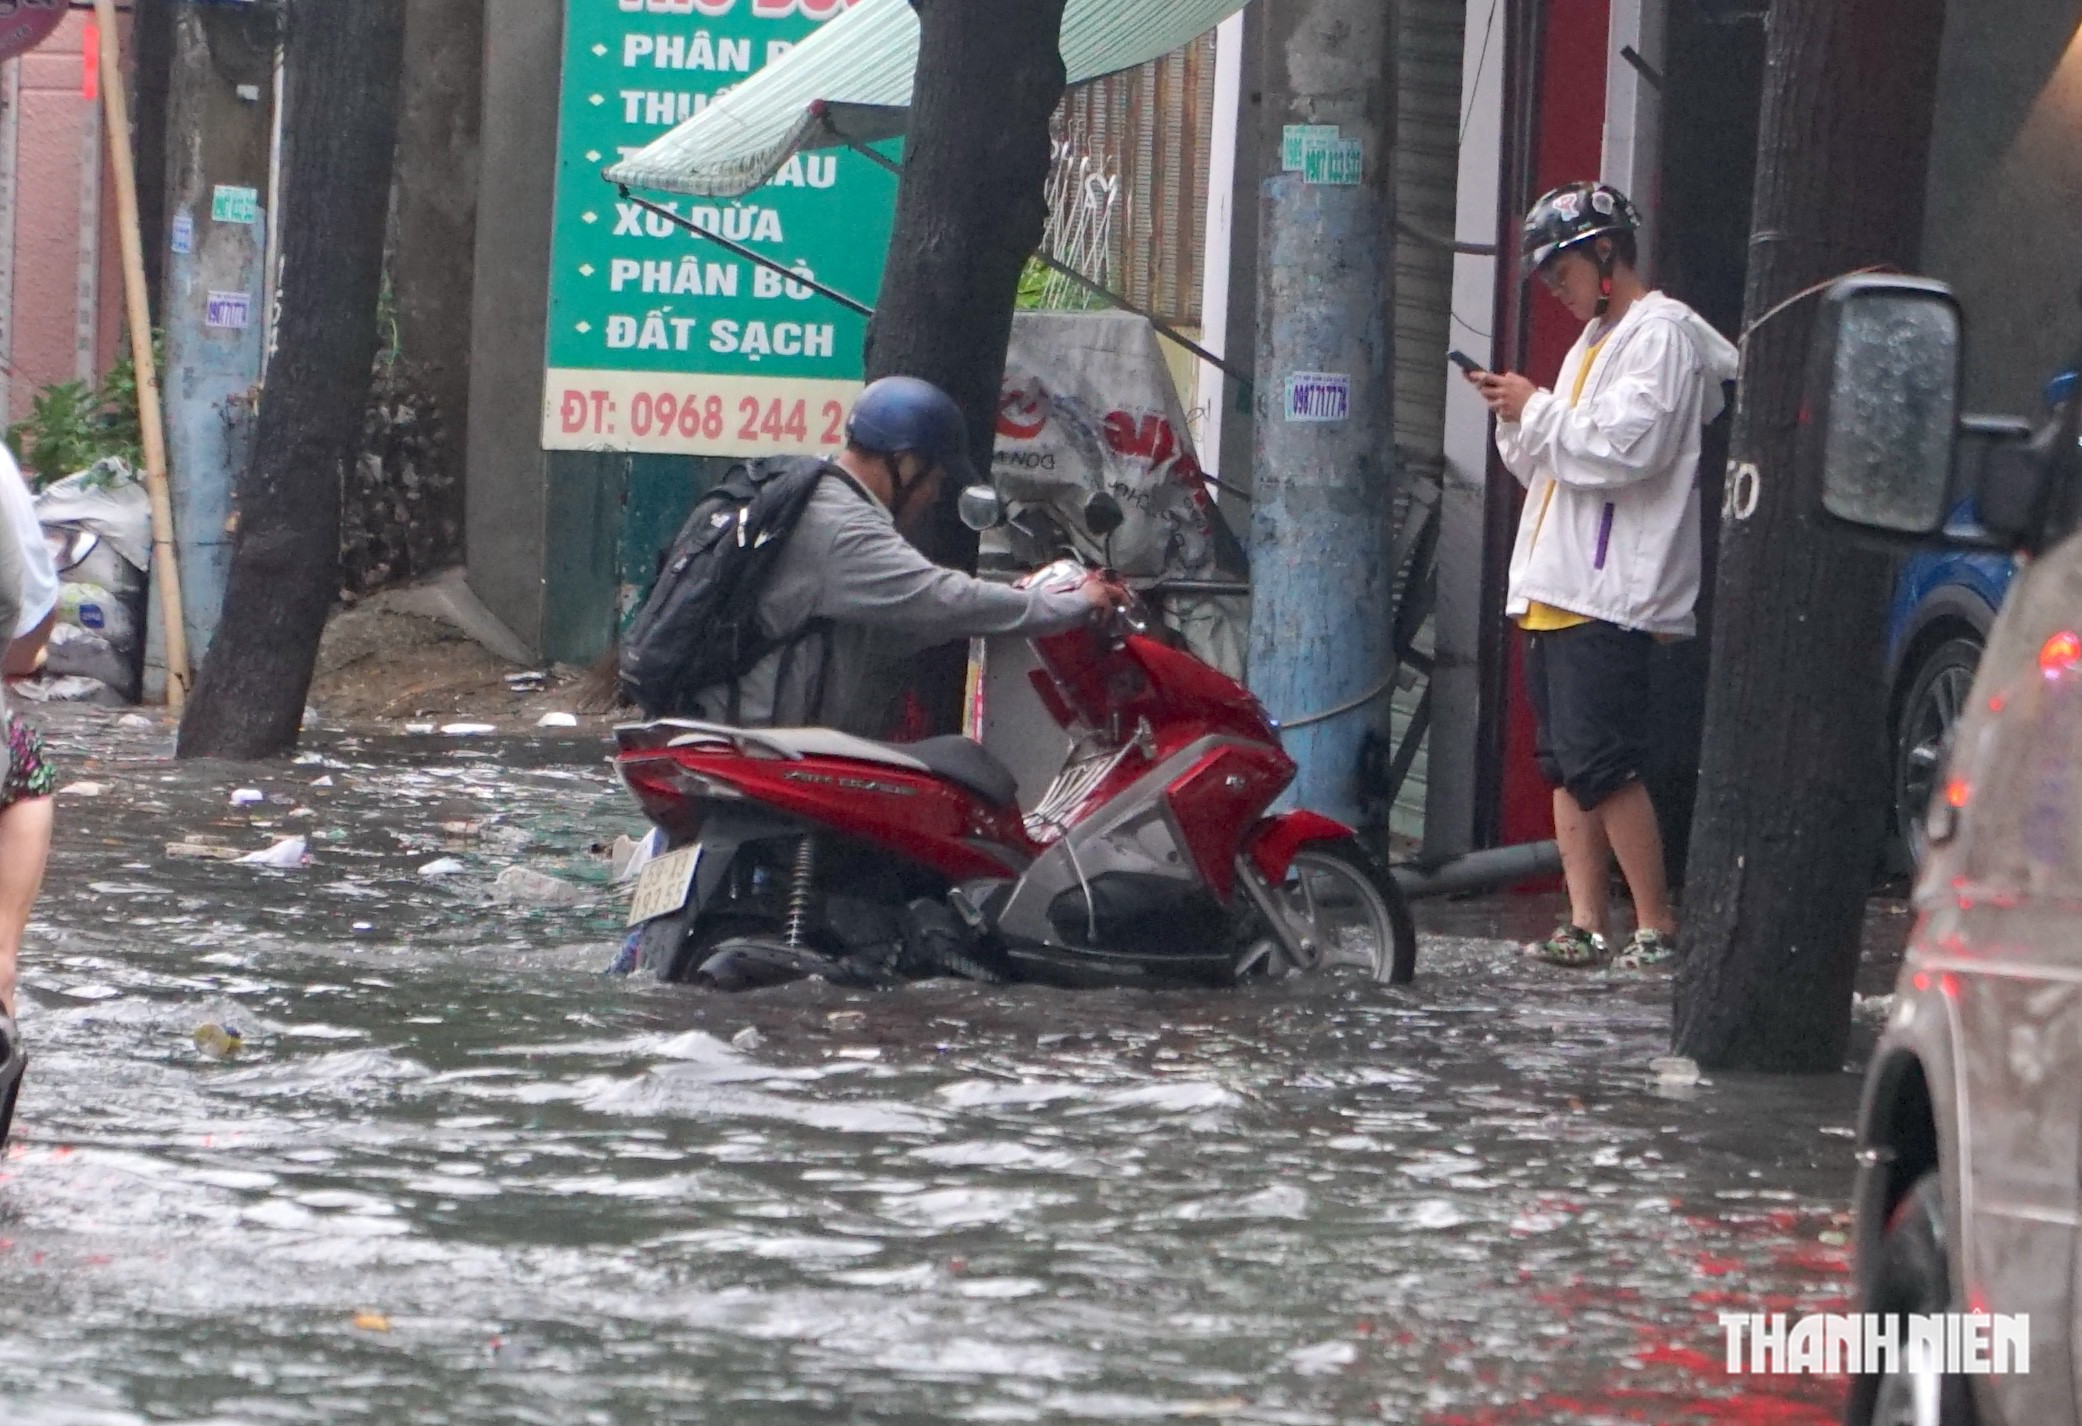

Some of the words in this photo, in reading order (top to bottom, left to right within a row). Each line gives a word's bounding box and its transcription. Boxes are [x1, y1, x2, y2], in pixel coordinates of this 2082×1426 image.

[623, 31, 751, 72] PHÂN
[619, 84, 740, 125] THU
[691, 200, 783, 242] DỪA
[610, 255, 738, 297] PHÂN
[753, 258, 815, 300] BÒ
[606, 306, 696, 350] ĐẤT
[709, 320, 834, 361] SẠCH
[561, 390, 616, 435] ĐT:
[631, 391, 724, 440] 0968
[737, 395, 807, 442] 244
